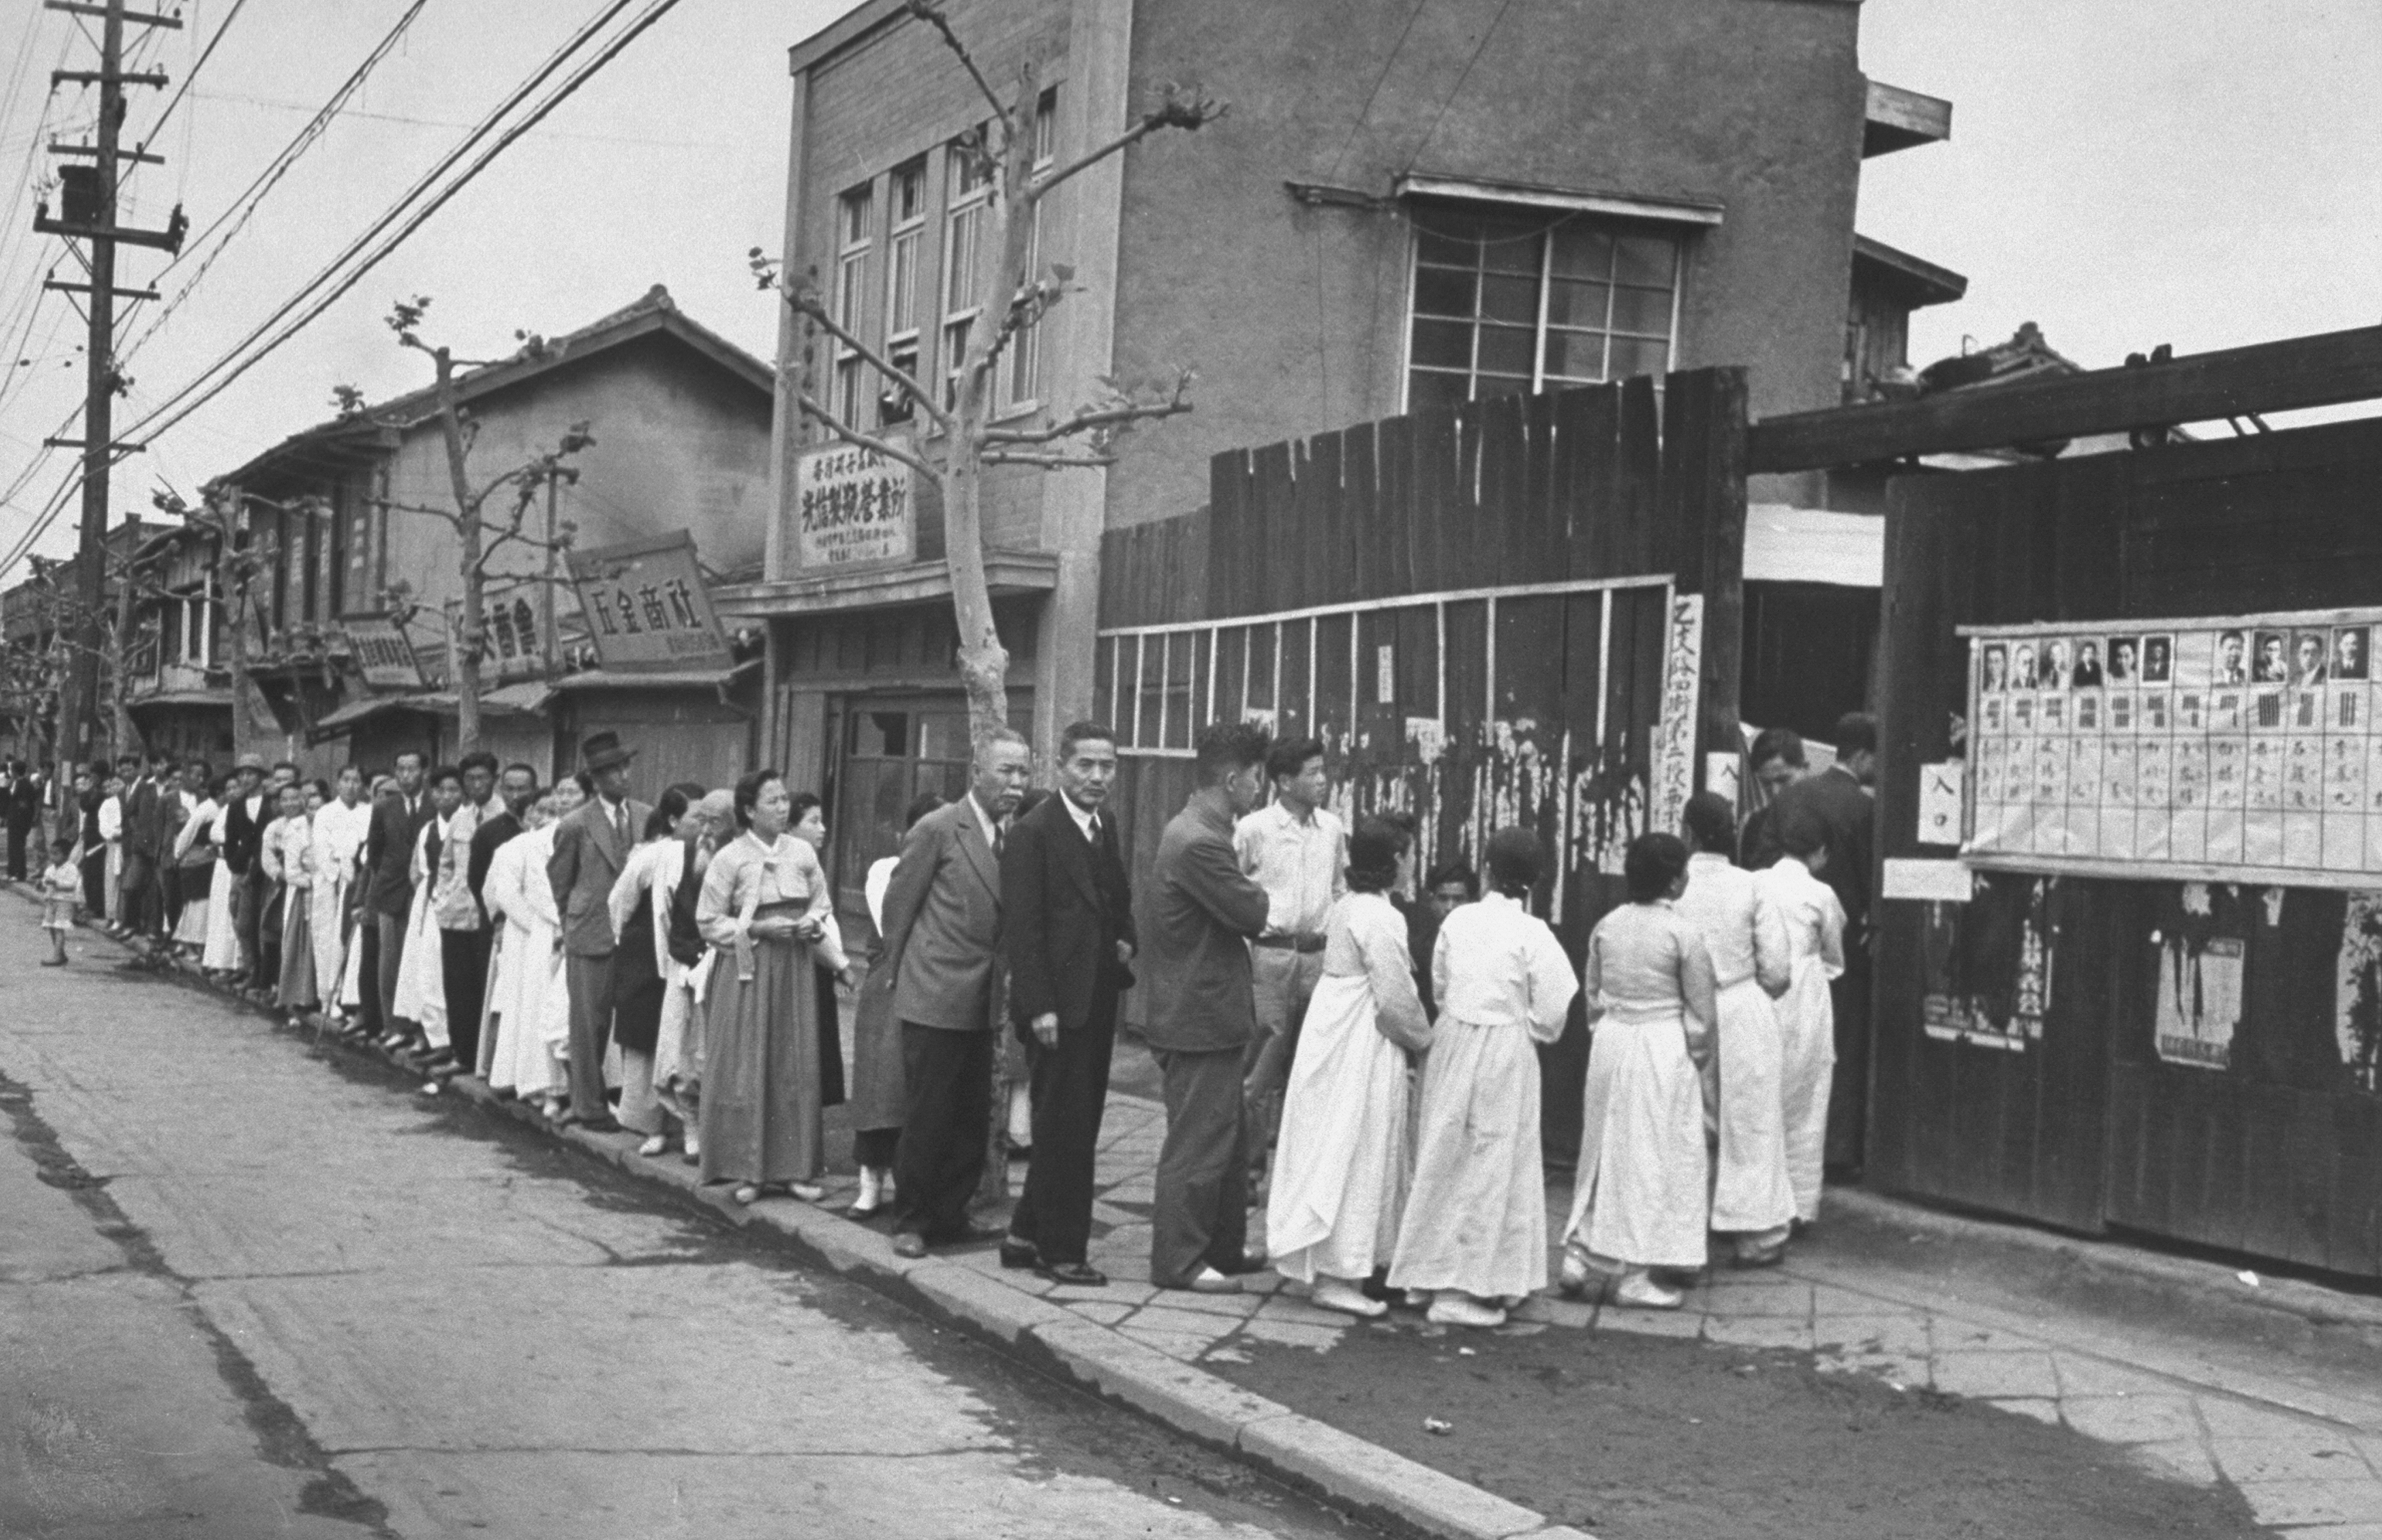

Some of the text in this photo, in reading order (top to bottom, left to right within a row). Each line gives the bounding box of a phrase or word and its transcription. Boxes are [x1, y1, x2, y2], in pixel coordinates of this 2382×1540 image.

[591, 578, 703, 635] 五金商社
[1931, 775, 1956, 827] 入口
